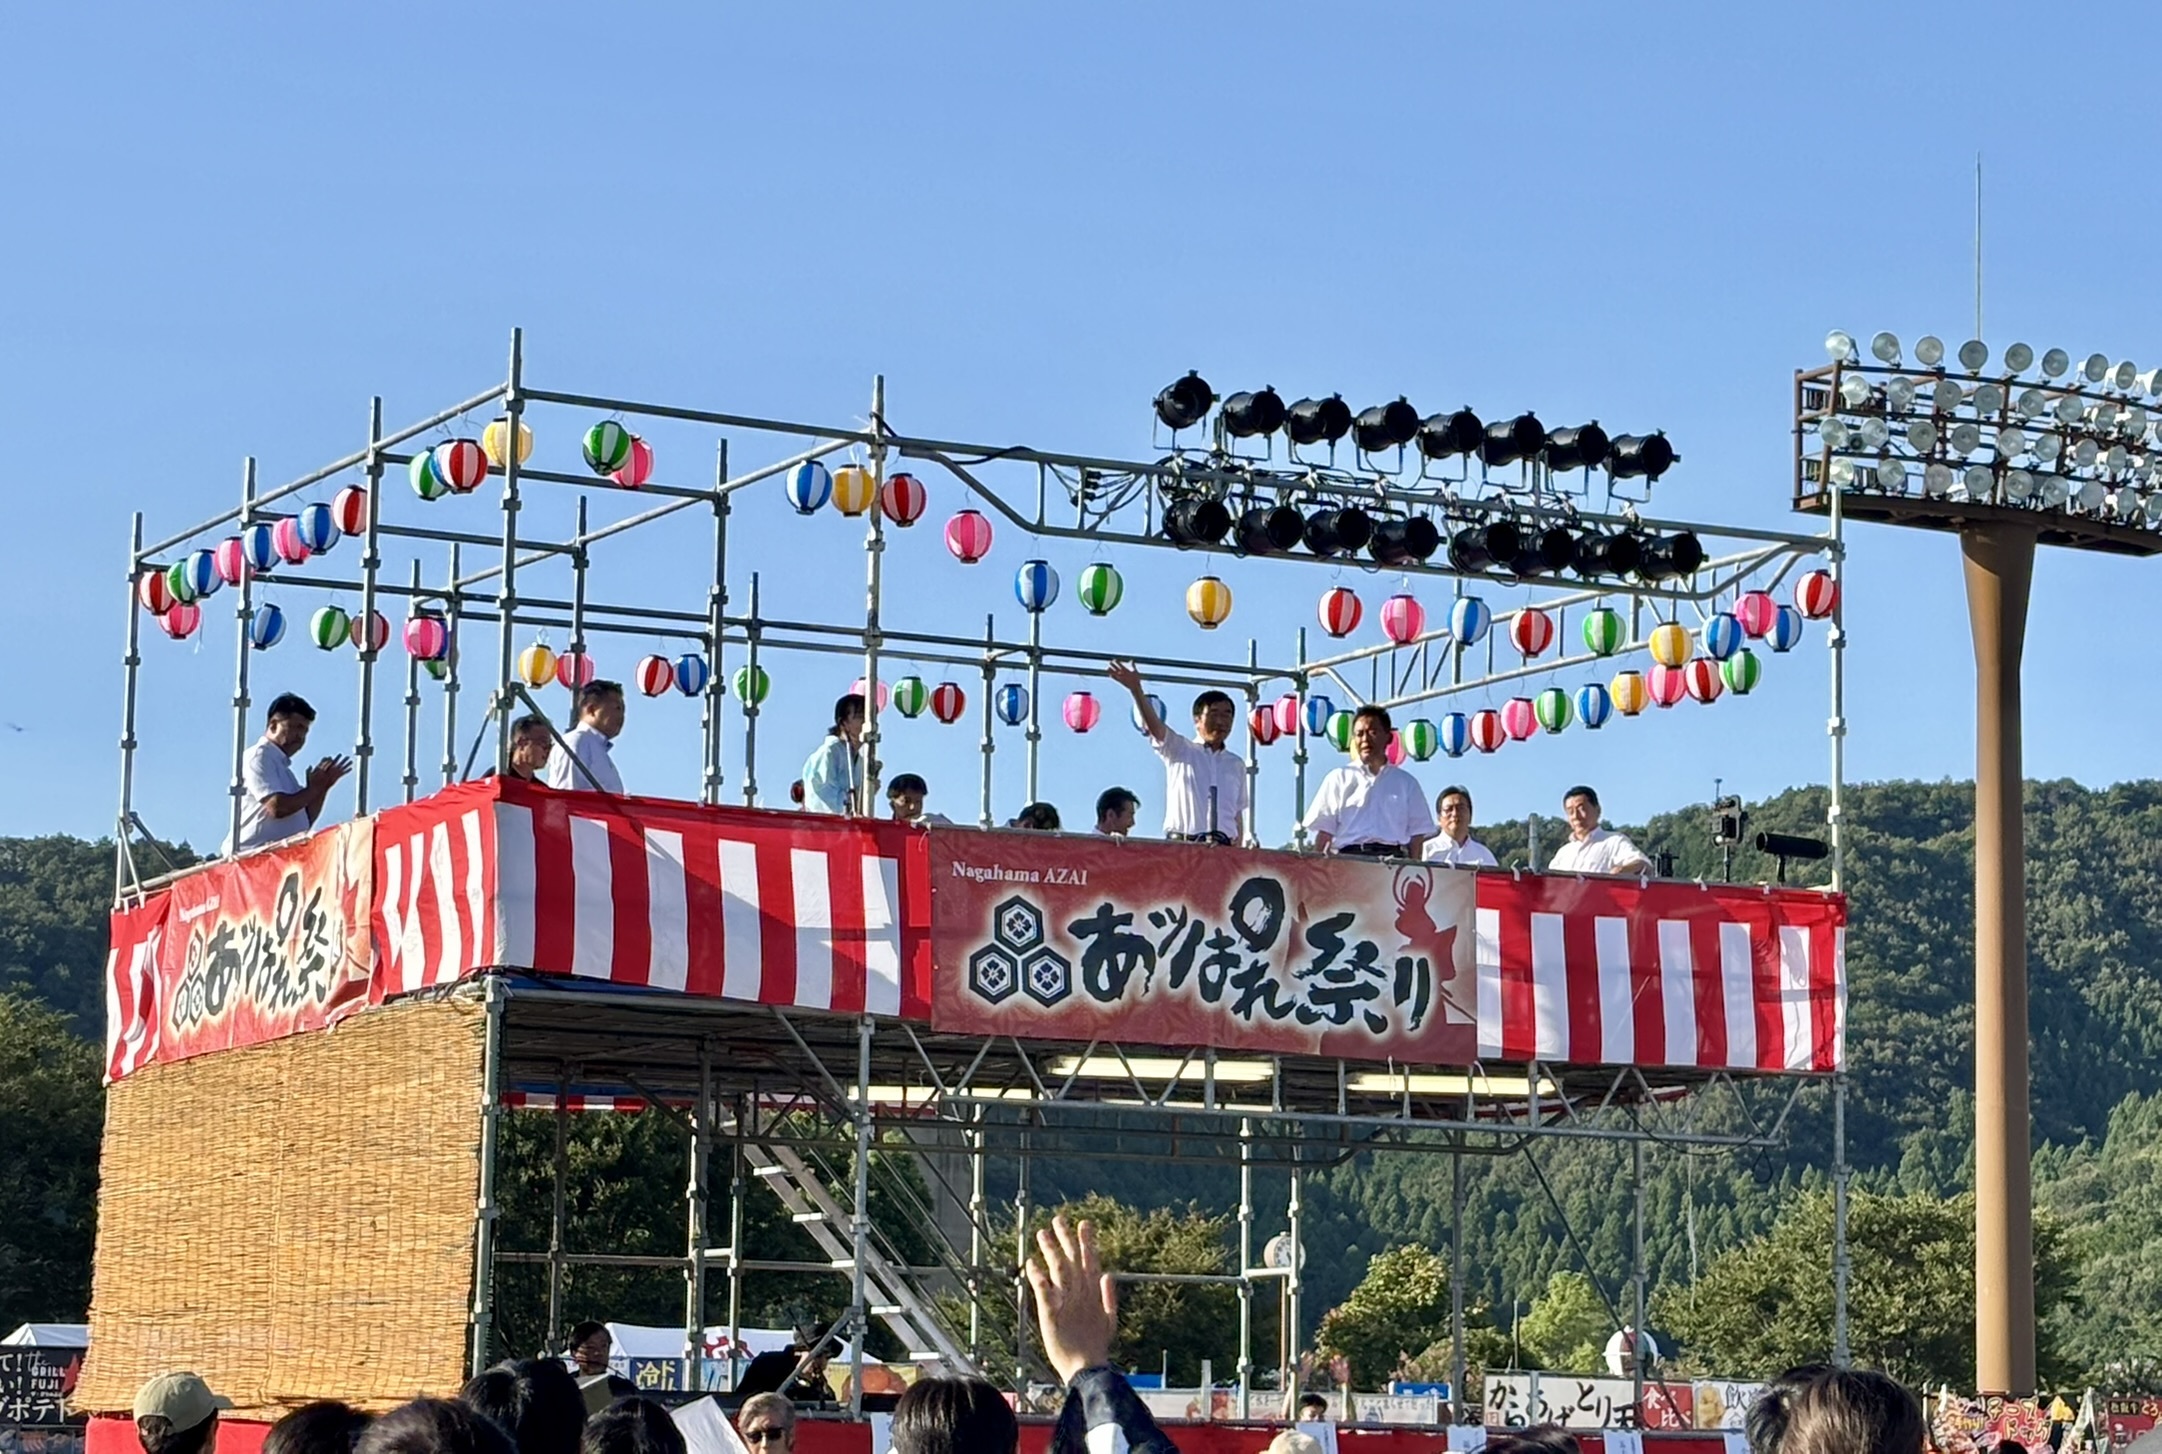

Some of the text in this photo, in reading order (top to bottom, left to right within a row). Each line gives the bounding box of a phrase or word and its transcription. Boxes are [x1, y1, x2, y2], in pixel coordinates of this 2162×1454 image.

[952, 861, 1088, 886] Nagahama AZAI
[31, 1366, 66, 1377] GRILL
[31, 1378, 59, 1390] FUJI
